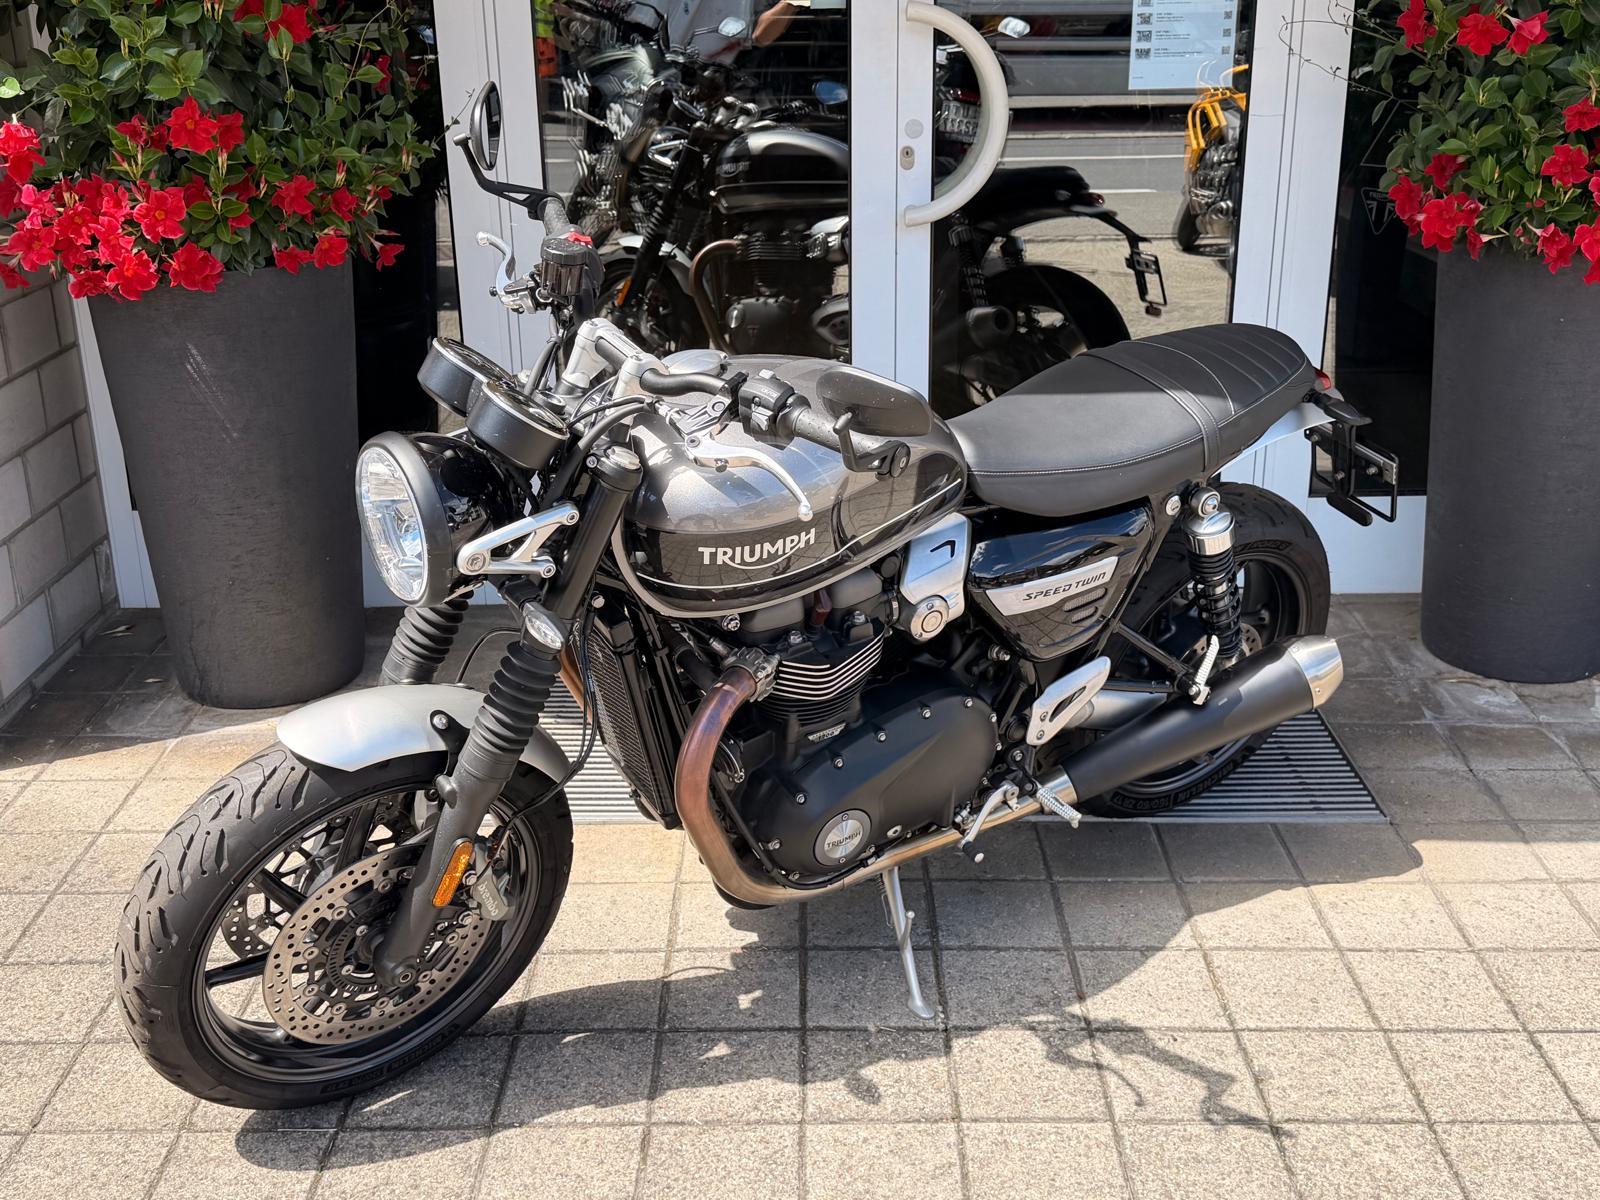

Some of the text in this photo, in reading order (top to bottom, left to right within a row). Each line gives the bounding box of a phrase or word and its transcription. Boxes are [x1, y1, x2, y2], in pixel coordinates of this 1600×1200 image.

[698, 528, 816, 569] TRIUMPH
[1022, 572, 1106, 601] SPEED TWIN
[1177, 761, 1234, 803] MICHELIN
[826, 831, 861, 848] TRIUMPH
[478, 881, 498, 916] brembo
